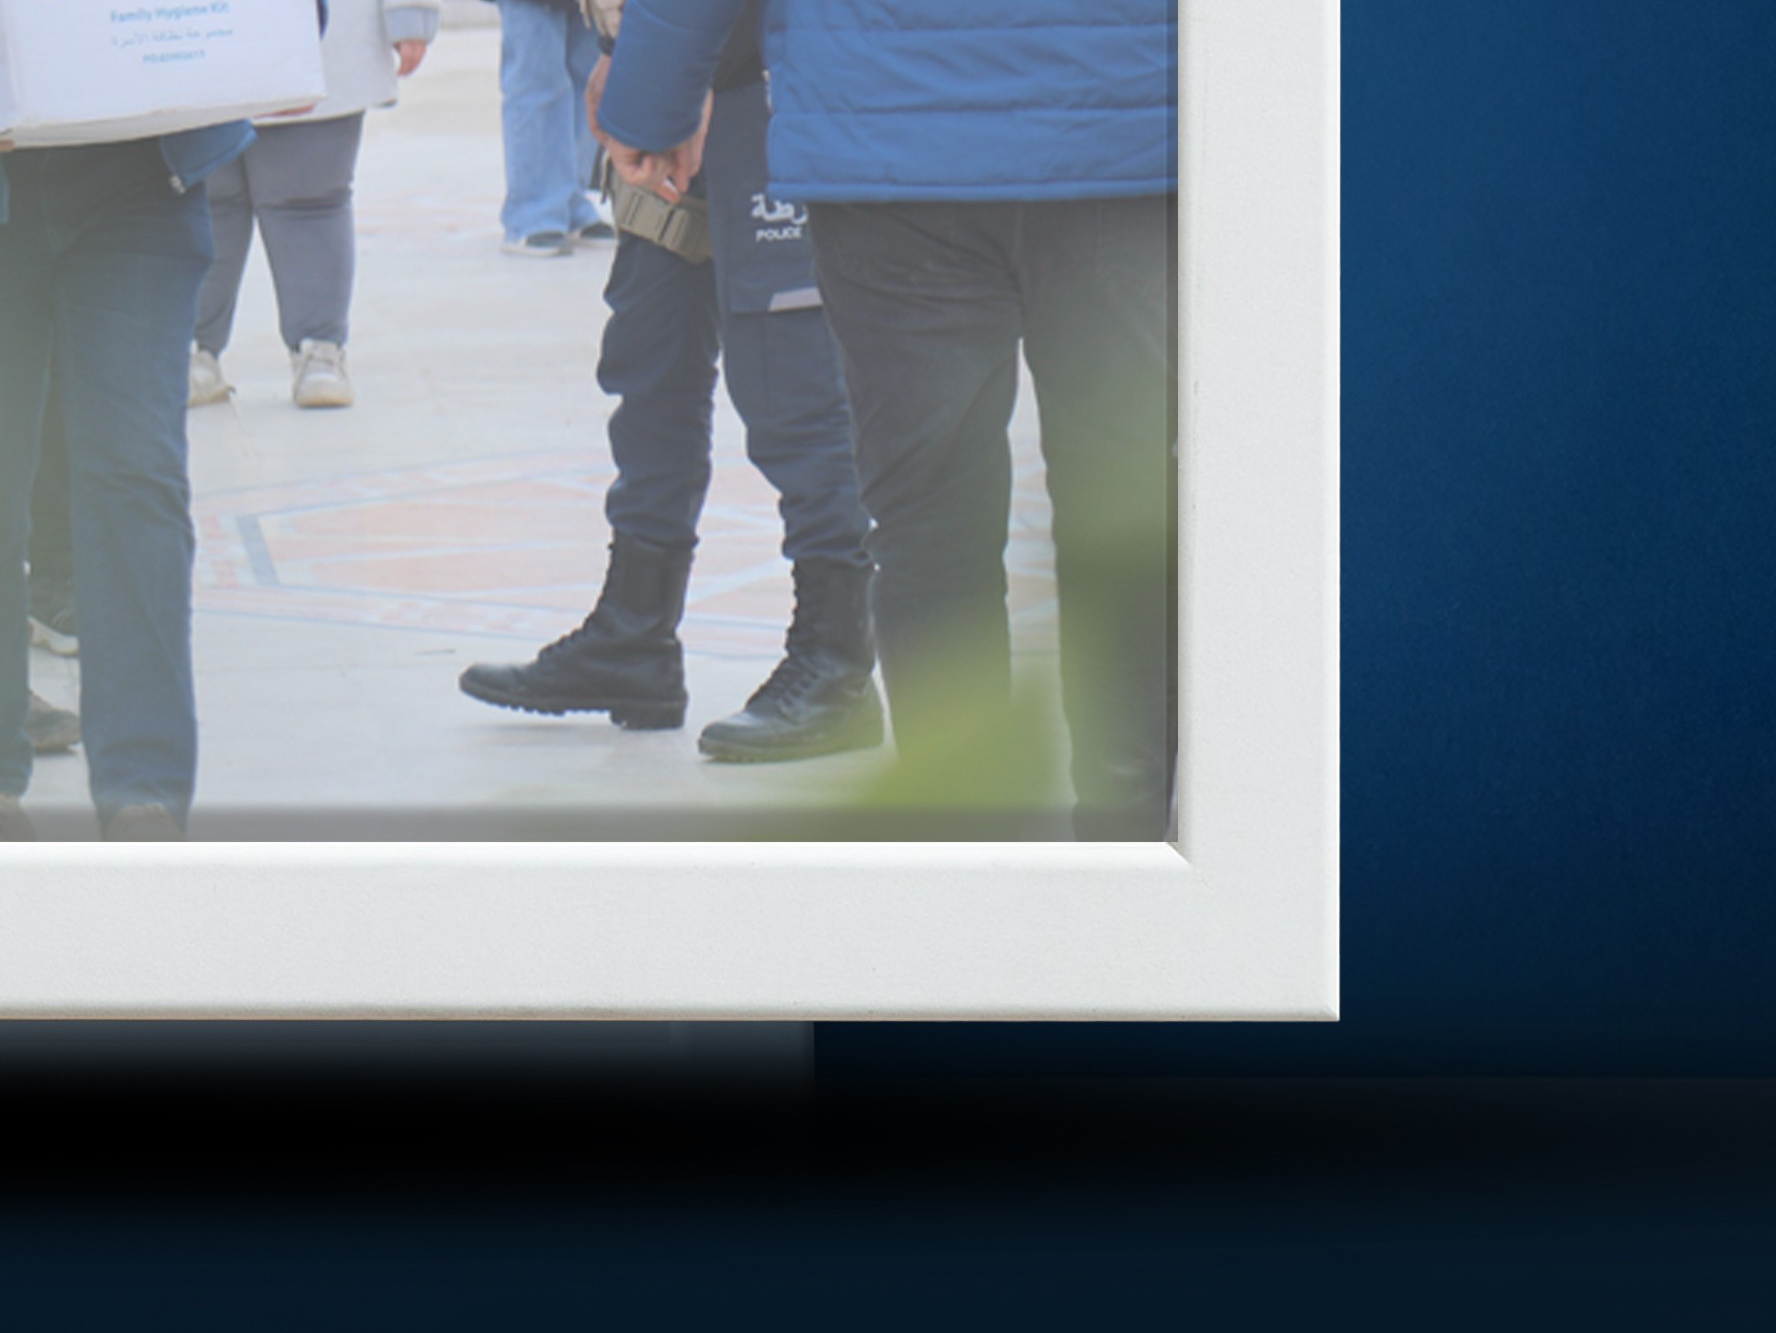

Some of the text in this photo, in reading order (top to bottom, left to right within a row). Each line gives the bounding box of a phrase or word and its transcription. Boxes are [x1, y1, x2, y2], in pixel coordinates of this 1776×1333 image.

[110, 8, 153, 23] Family
[751, 193, 809, 225] رطة
[756, 227, 802, 242] POLICE
